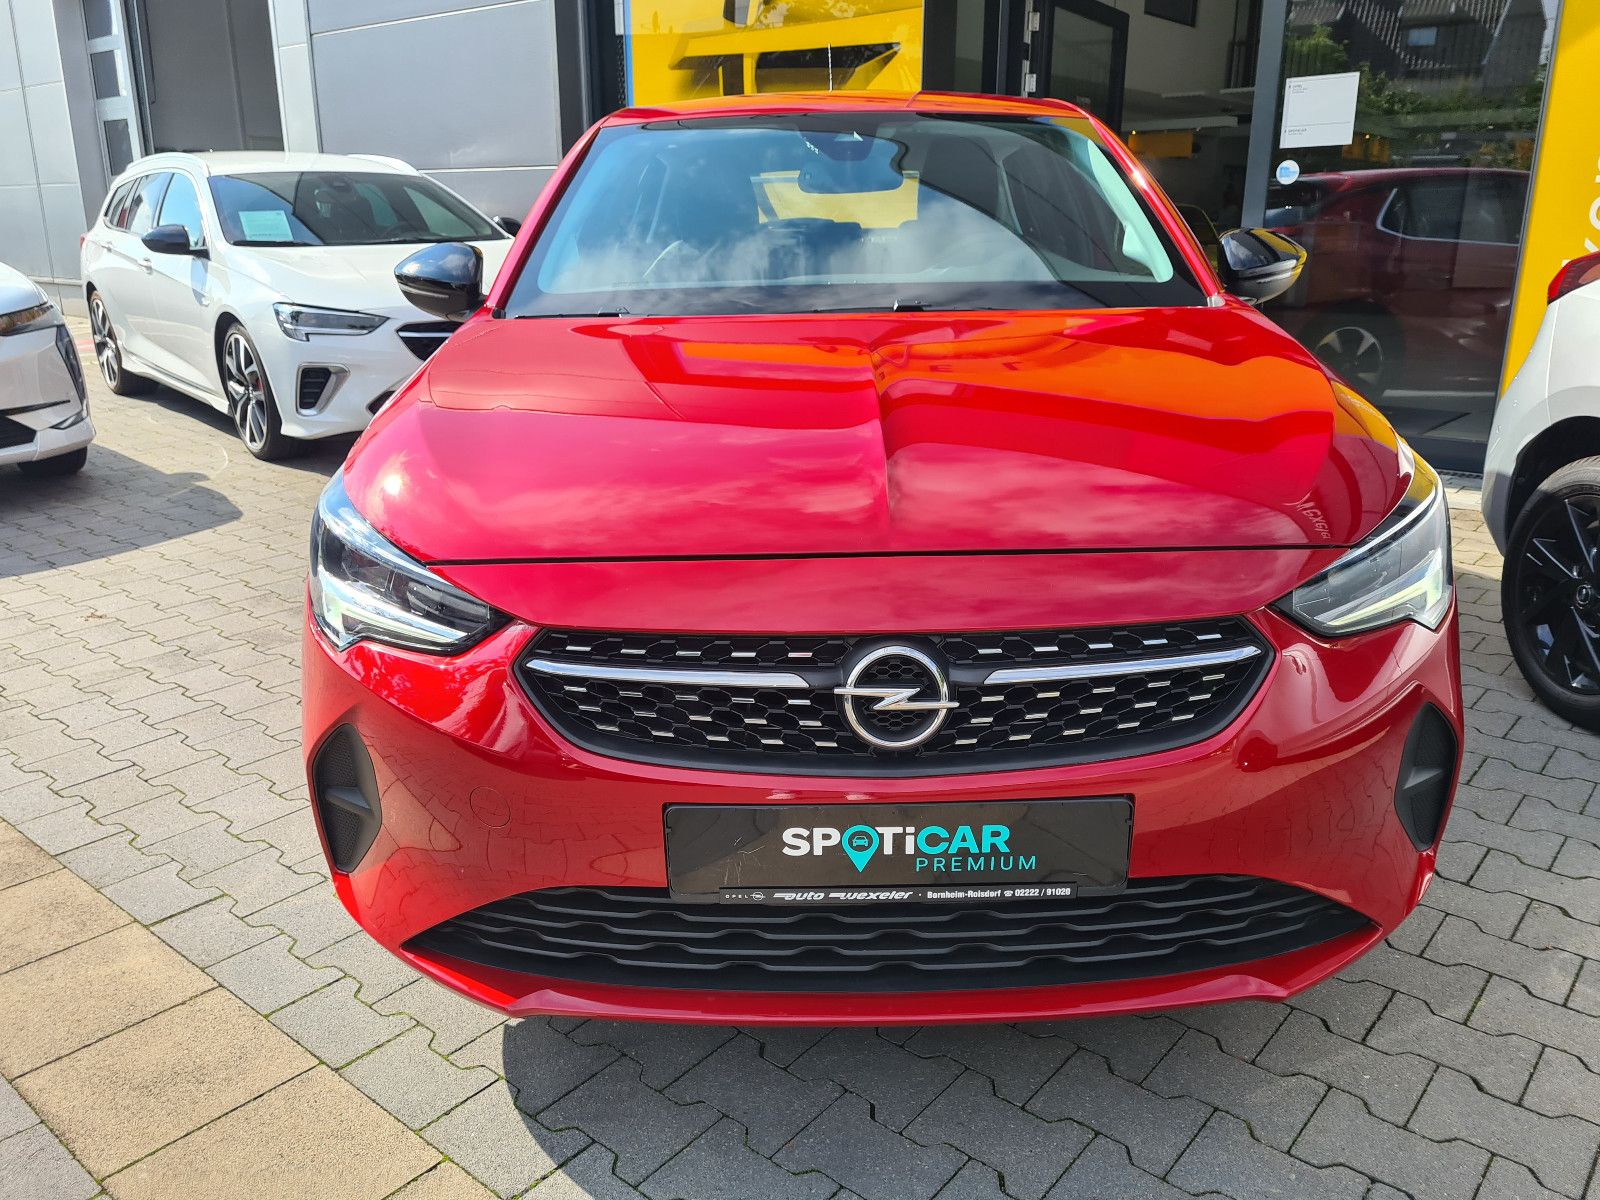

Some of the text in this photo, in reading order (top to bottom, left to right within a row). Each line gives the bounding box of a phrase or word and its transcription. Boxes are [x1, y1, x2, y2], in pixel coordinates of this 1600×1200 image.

[915, 855, 1037, 873] PREMIUM
[773, 891, 825, 901] auto
[927, 889, 1001, 899] Bornheim-Roisdorf
[1015, 888, 1040, 897] 02222
[1046, 887, 1071, 896] 91020
